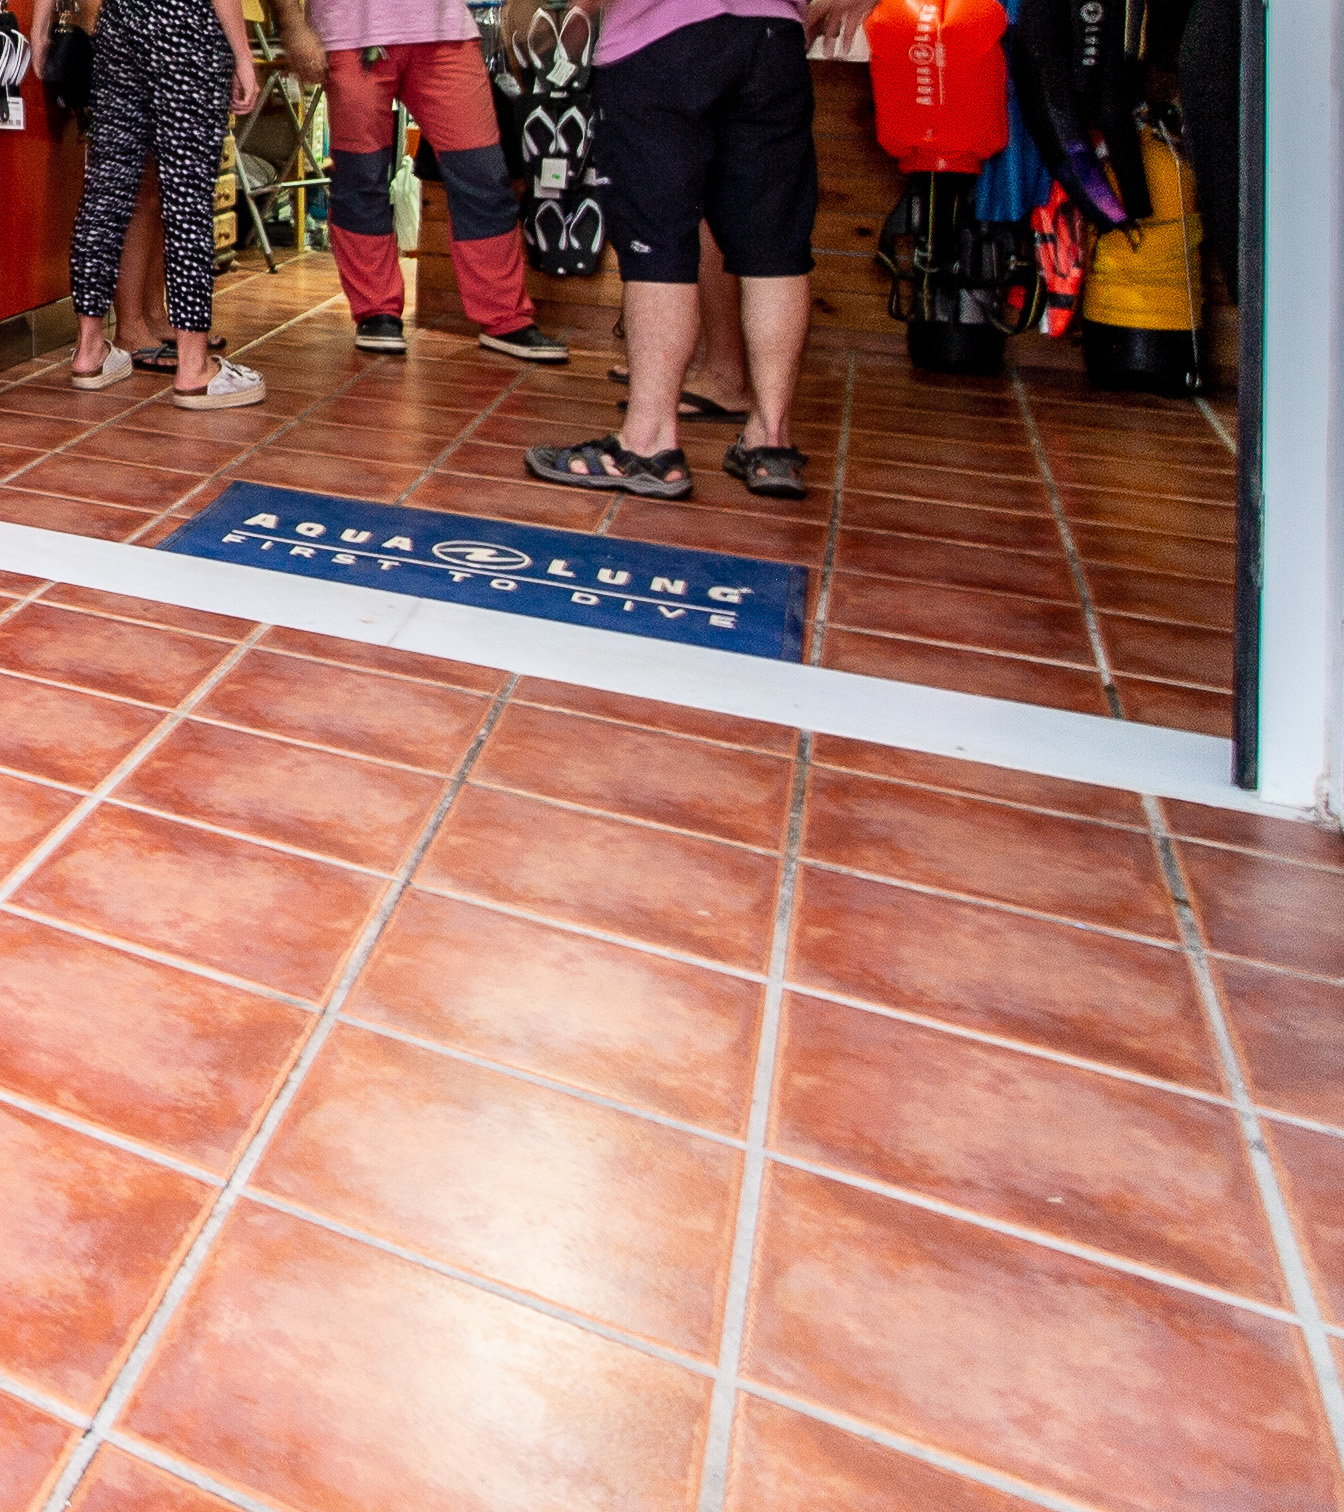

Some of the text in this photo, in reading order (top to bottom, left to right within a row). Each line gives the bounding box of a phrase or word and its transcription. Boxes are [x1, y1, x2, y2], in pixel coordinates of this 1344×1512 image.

[220, 531, 738, 631] FIRST TO DIVE
[242, 511, 749, 605] AQUA LUNG
